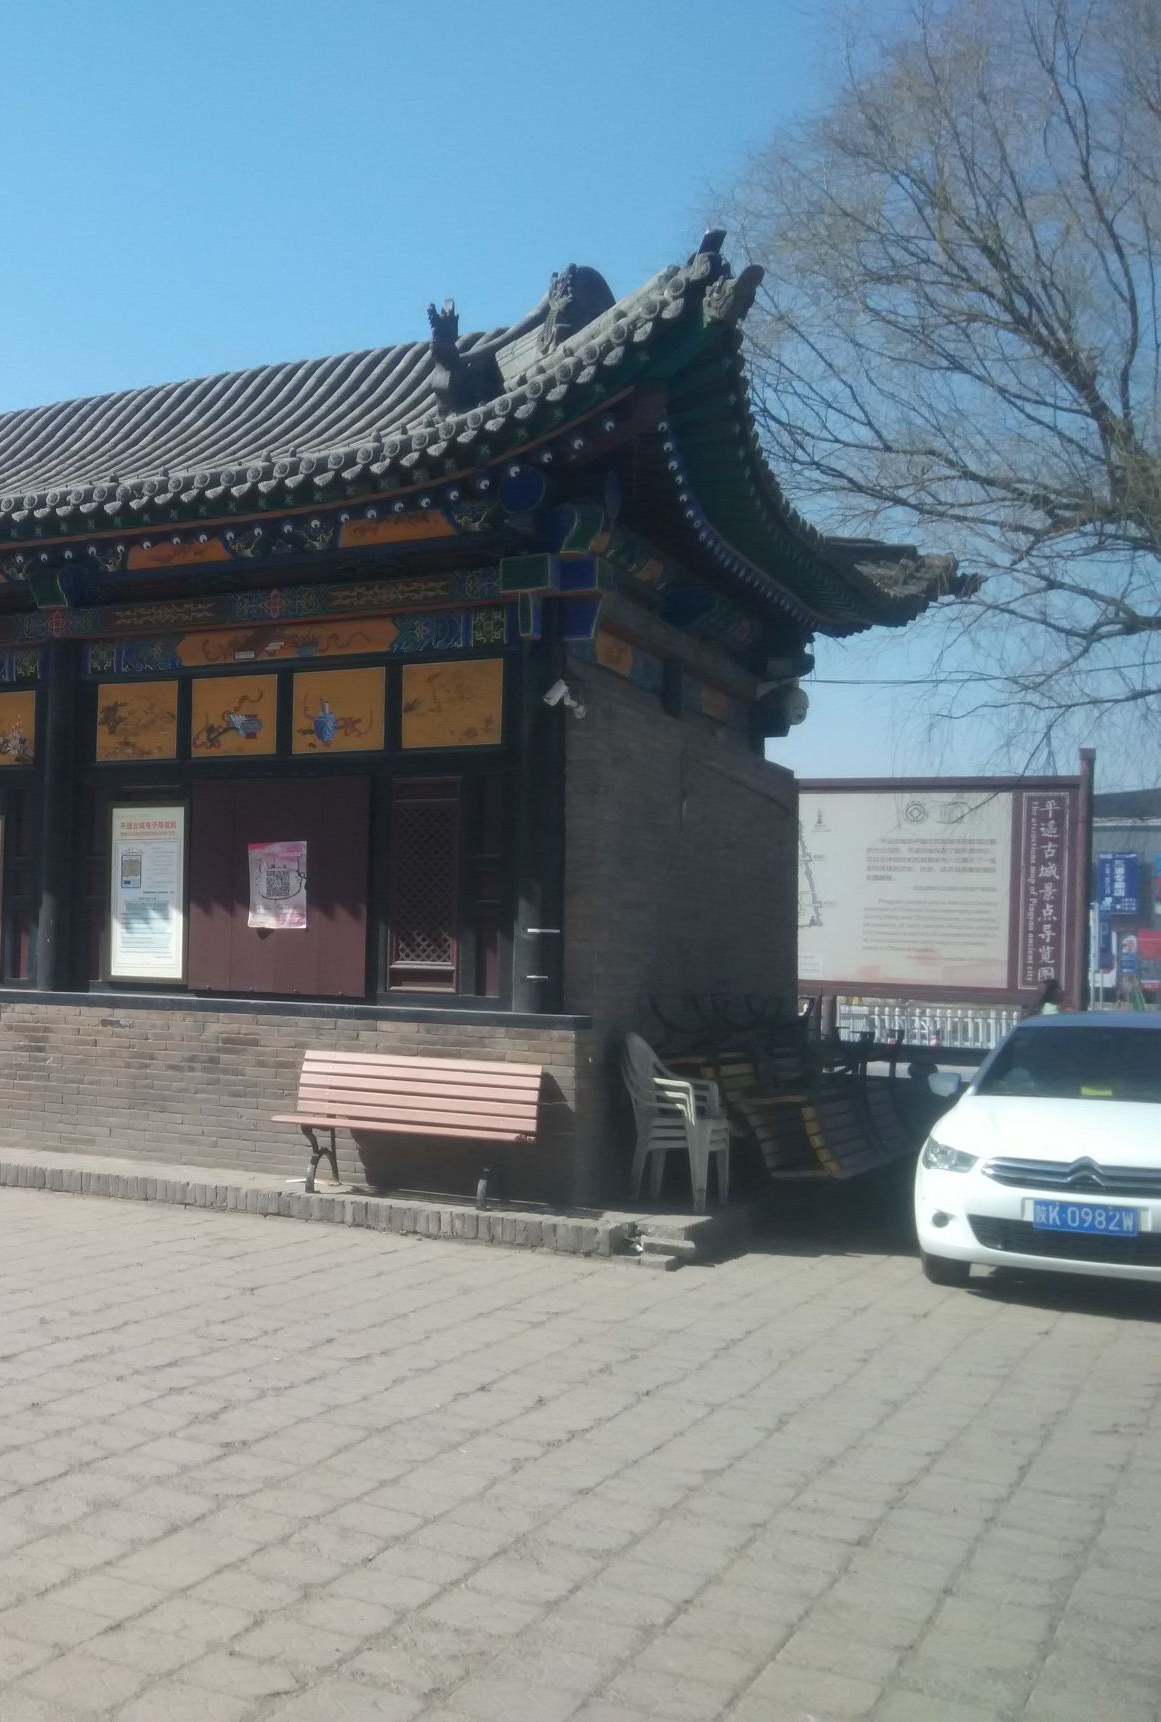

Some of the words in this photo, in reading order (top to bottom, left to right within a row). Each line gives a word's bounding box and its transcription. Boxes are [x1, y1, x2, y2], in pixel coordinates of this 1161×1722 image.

[1038, 800, 1060, 982] 平遥古城景点导览图
[1027, 933, 1035, 964] ancient
[1023, 966, 1035, 981] city
